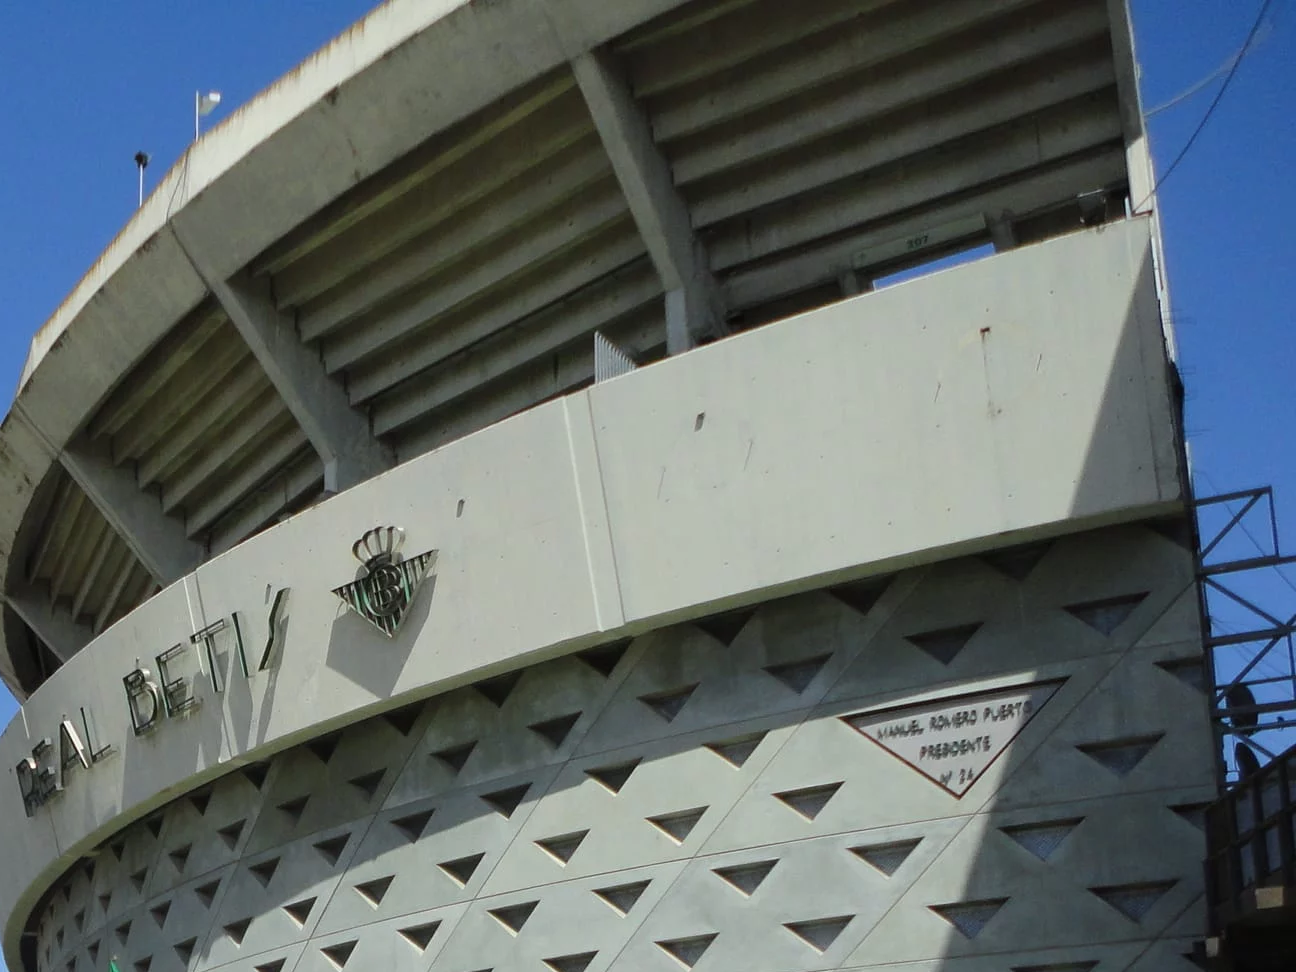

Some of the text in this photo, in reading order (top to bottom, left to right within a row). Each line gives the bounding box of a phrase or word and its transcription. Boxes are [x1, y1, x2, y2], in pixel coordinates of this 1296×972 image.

[877, 700, 1033, 741] MANUEL ROMERO PUERTO
[919, 735, 991, 760] PRESIDENTE
